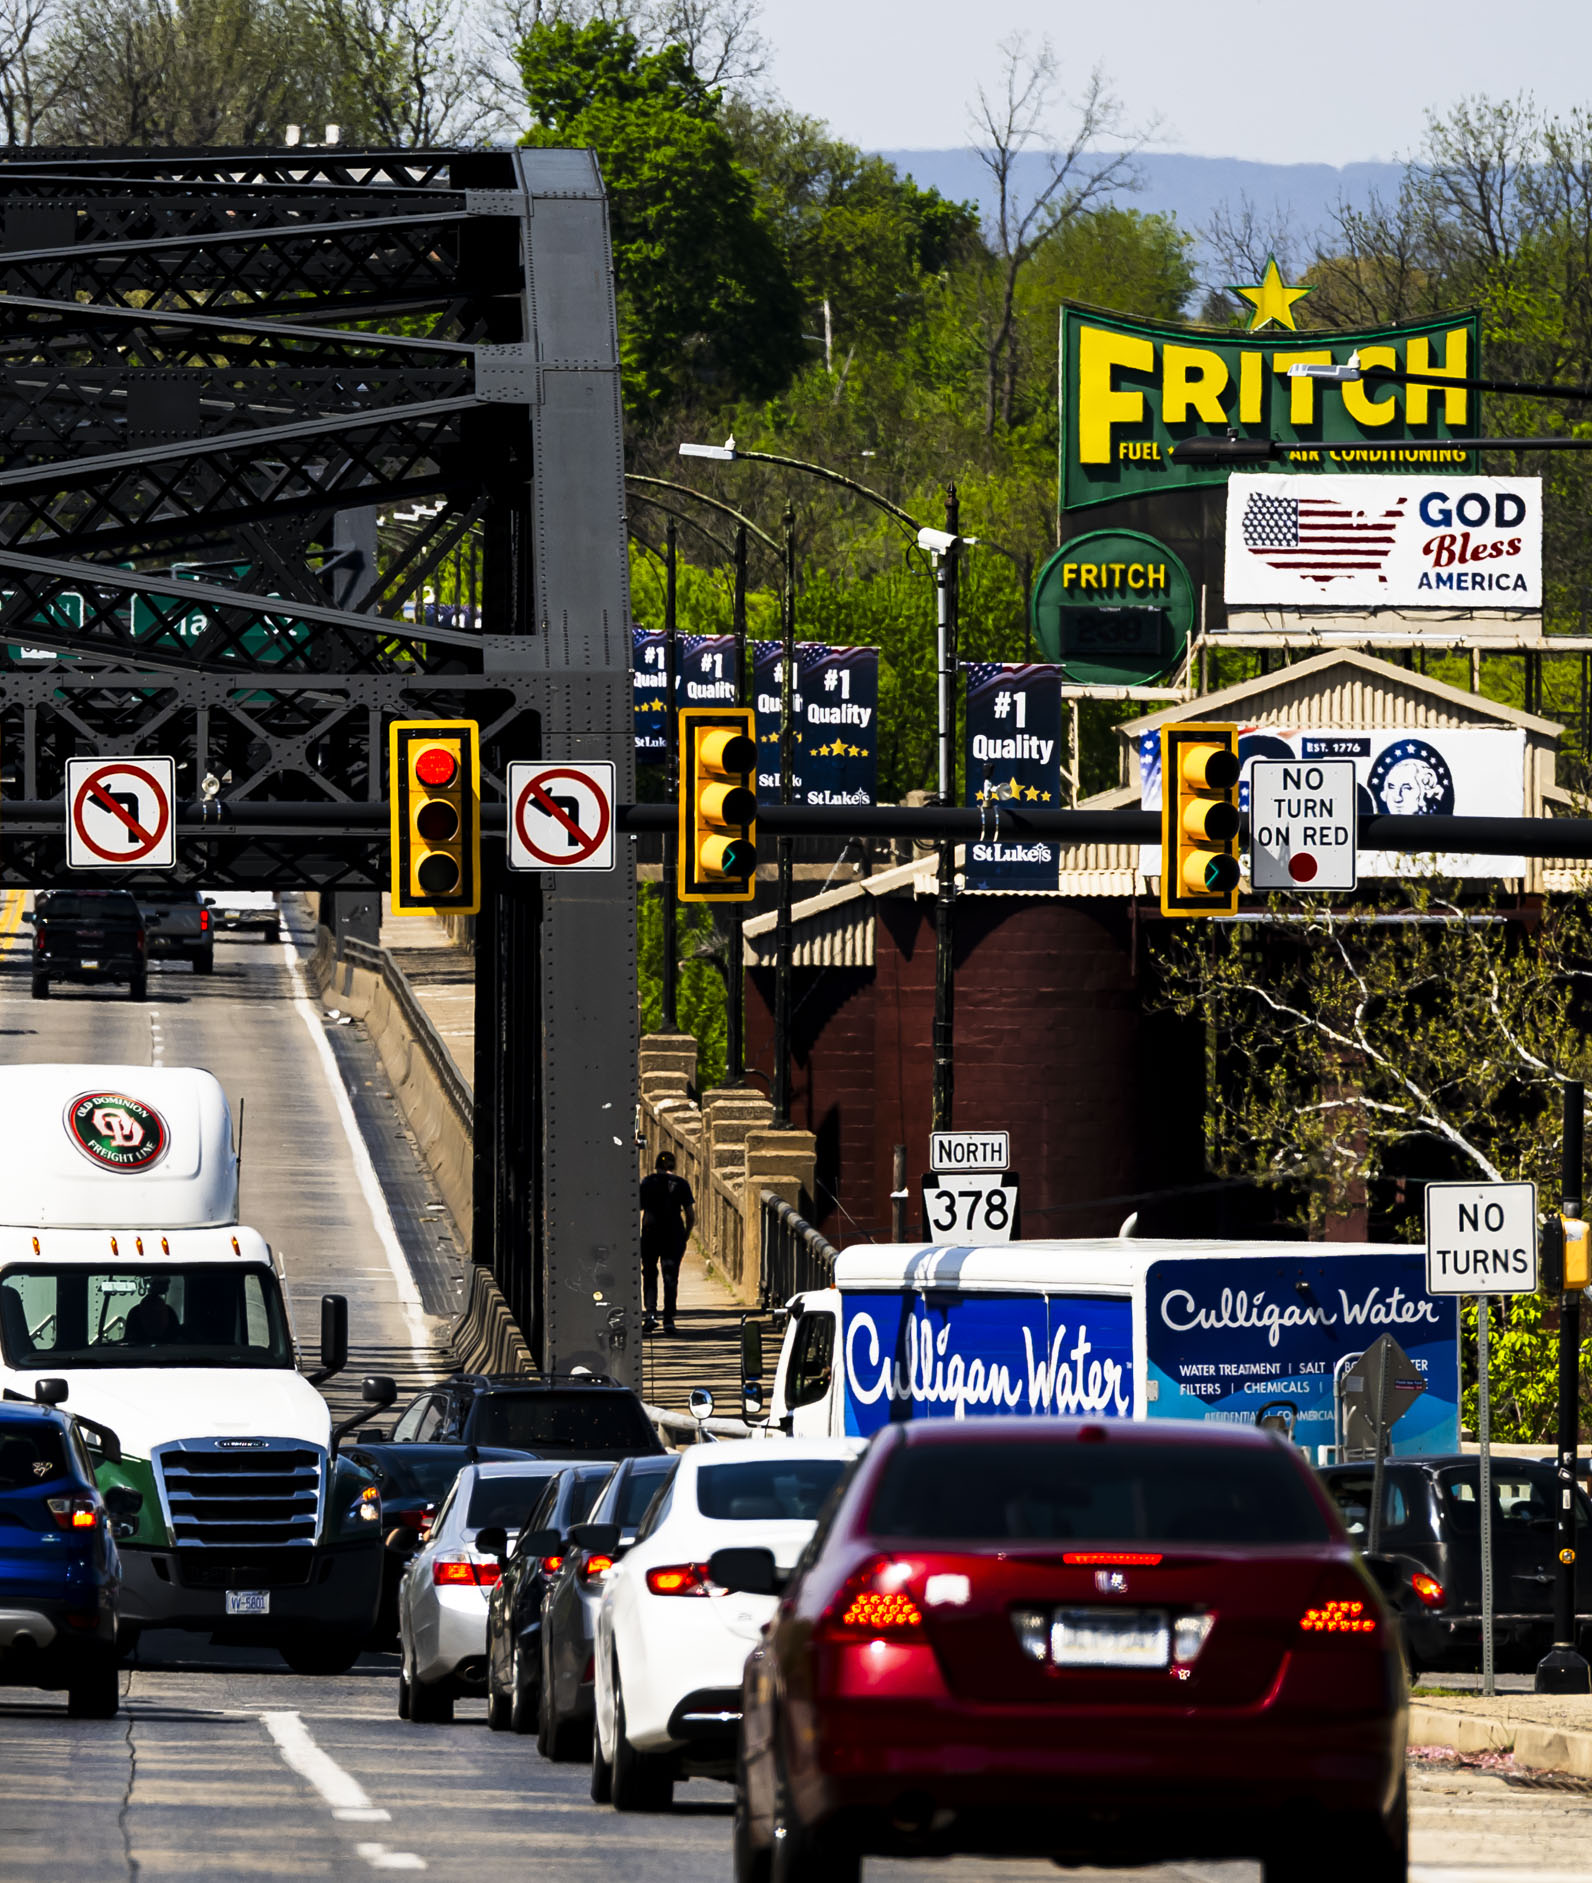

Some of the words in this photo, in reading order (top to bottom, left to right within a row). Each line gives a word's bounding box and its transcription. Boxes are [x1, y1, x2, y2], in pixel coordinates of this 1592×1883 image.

[1080, 326, 1468, 464] FRITCH
[1118, 442, 1161, 462] FUEL
[1419, 492, 1527, 529] GOD
[1422, 533, 1523, 568] Bless
[1062, 562, 1166, 589] FRITCH
[1417, 572, 1529, 592] AMERICA
[644, 646, 665, 670] #1
[700, 653, 724, 678] #1
[824, 669, 851, 699] #1
[808, 704, 872, 728] Quality
[994, 691, 1027, 729] #1
[973, 735, 1054, 765] Quality
[1306, 741, 1329, 753] EST.
[1333, 743, 1361, 753] 1776
[1282, 768, 1324, 791] NO
[1274, 799, 1334, 819] TURN
[1258, 827, 1290, 847] ON
[1304, 827, 1349, 847] RED
[77, 1100, 94, 1117] OLD
[92, 1096, 150, 1118] DOMINION
[87, 1139, 134, 1162] FREIGHT
[136, 1140, 156, 1160] LINE
[937, 1140, 1004, 1165] NORTH
[932, 1189, 1009, 1232] 378
[1458, 1204, 1506, 1234] NO
[1436, 1250, 1528, 1275] TURNS
[1161, 1287, 1338, 1348] Culligan
[1338, 1286, 1440, 1324] Water
[846, 1312, 1023, 1421] Culligan
[1022, 1324, 1130, 1409] Water
[1179, 1364, 1216, 1377] WATER
[1219, 1362, 1281, 1376] TREATMENT
[1299, 1362, 1326, 1374] SALT
[1179, 1383, 1221, 1396] FILTERS
[1244, 1381, 1310, 1395] CHEMICALS
